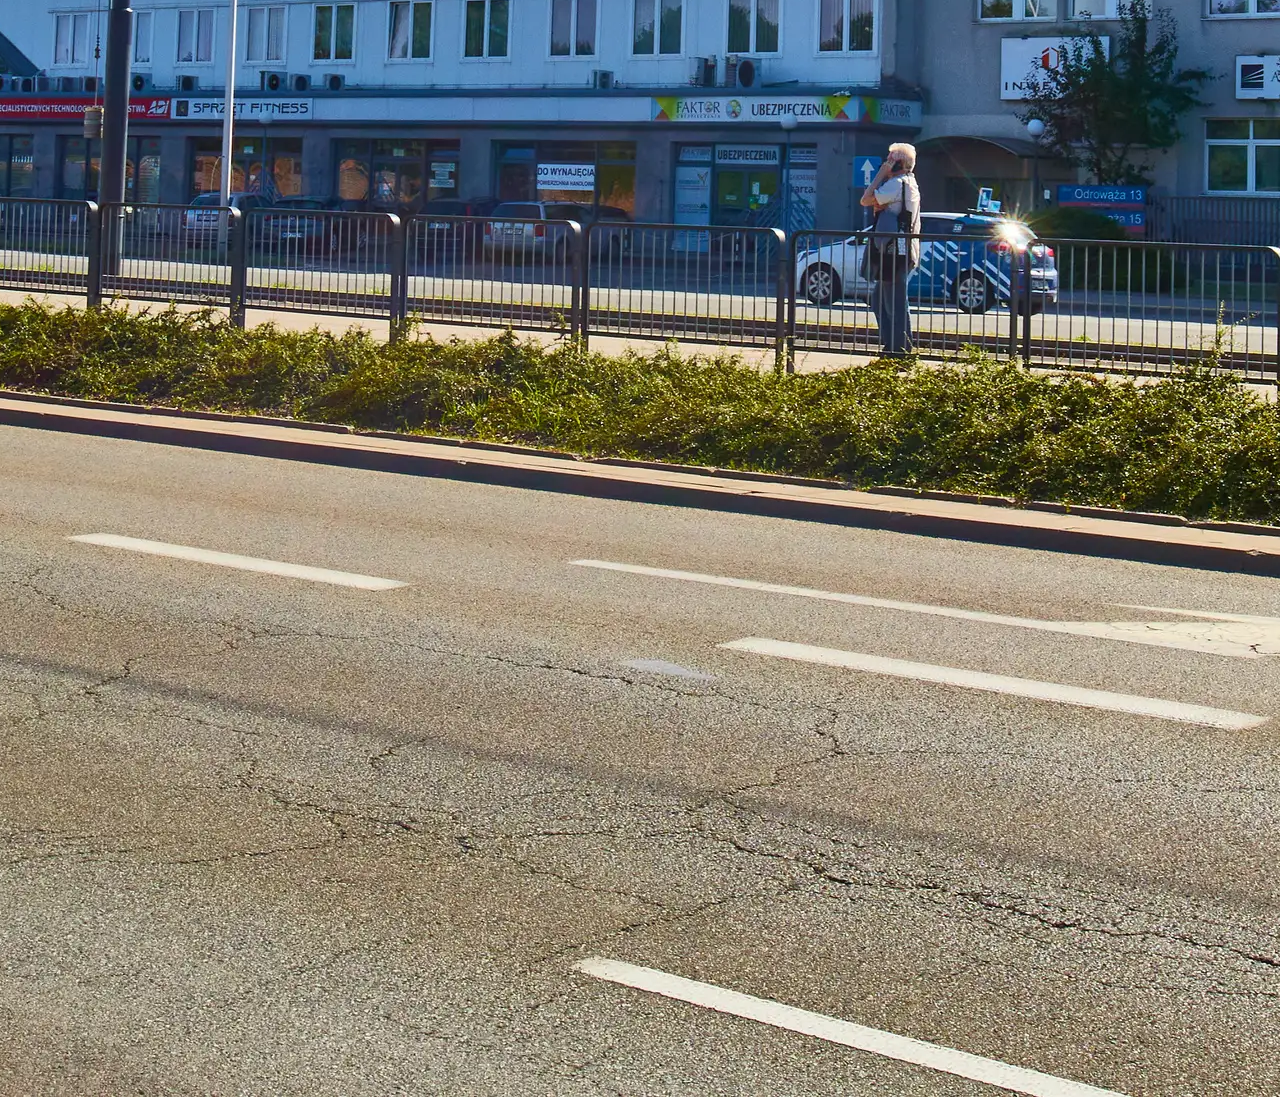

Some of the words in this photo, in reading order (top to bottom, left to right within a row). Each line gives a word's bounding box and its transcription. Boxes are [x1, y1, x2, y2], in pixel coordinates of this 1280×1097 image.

[250, 103, 309, 114] FITNESS
[676, 101, 721, 113] FAKTOR
[751, 103, 832, 117] UBEZPIECZENIA
[717, 149, 778, 161] UBEZPIECZENIA
[537, 167, 549, 176] DO
[550, 167, 596, 178] WYNAJĘCIA
[1074, 188, 1126, 202] Odrowąża
[1130, 189, 1142, 201] 13
[1129, 213, 1142, 225] 15
